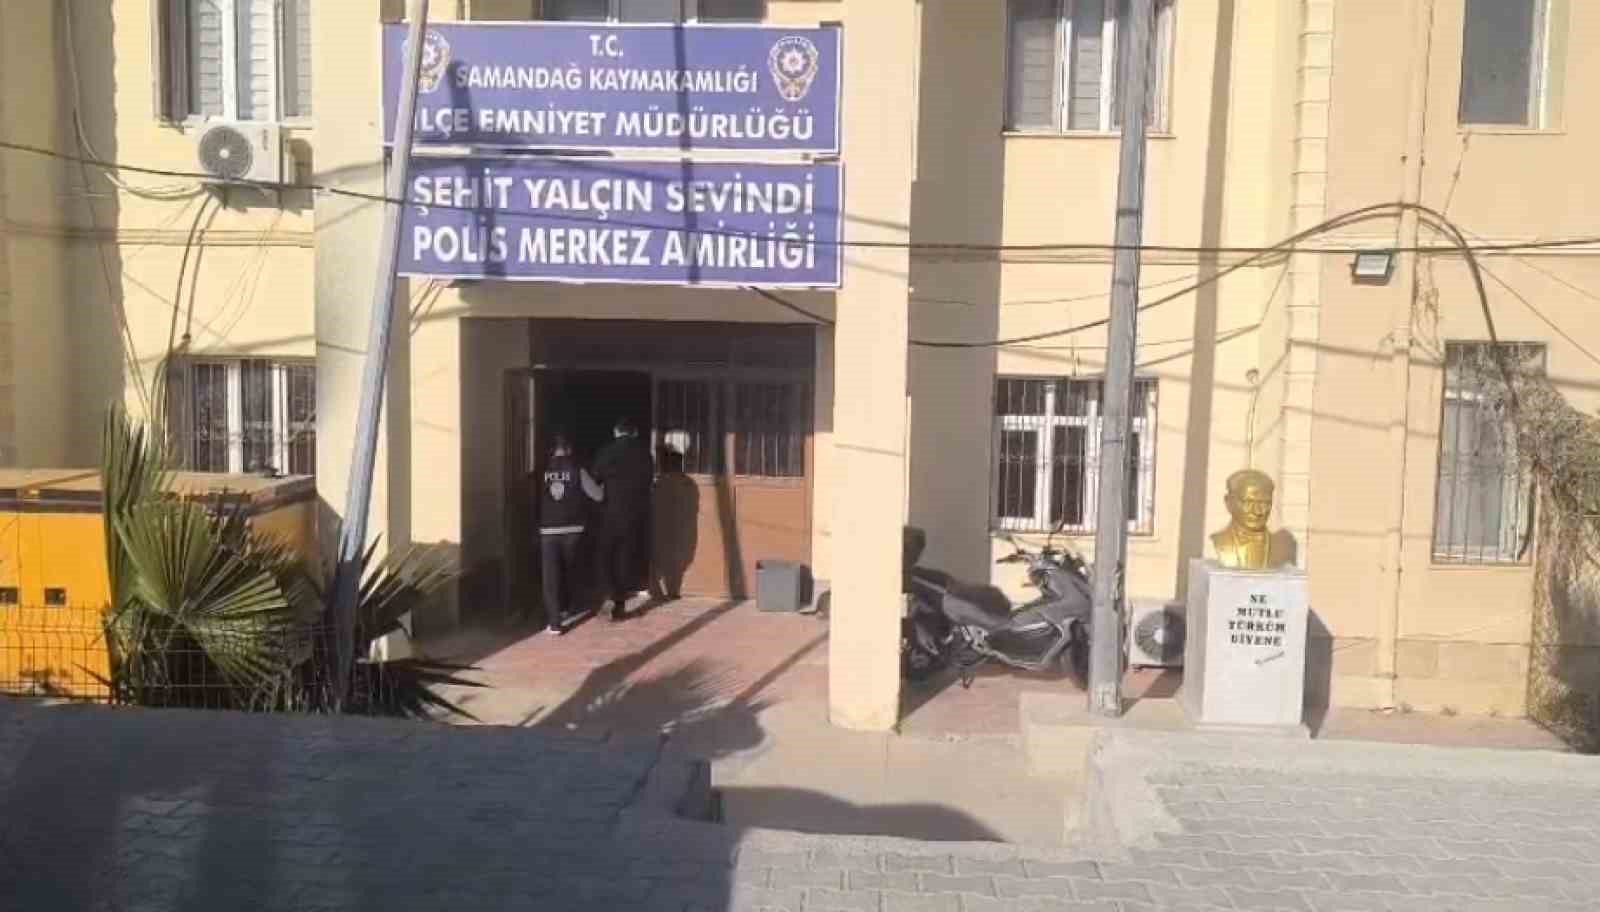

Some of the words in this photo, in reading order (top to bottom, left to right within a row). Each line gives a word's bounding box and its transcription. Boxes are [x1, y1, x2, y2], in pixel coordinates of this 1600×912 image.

[589, 34, 624, 57] T.C.
[456, 61, 582, 90] SAMANDAĞ
[589, 64, 758, 94] KAYMAKAMLIĞI
[479, 103, 606, 135] EMNİYET
[615, 105, 814, 140] MÜDÜRLÜĞÜ
[413, 167, 512, 216] ŞEHİT
[524, 178, 653, 220] YALÇIN
[665, 171, 814, 215] SEVİNDİ
[413, 213, 507, 263] POLİS
[518, 226, 652, 266] MERKEZ
[661, 219, 816, 270] AMİRLİĞİ
